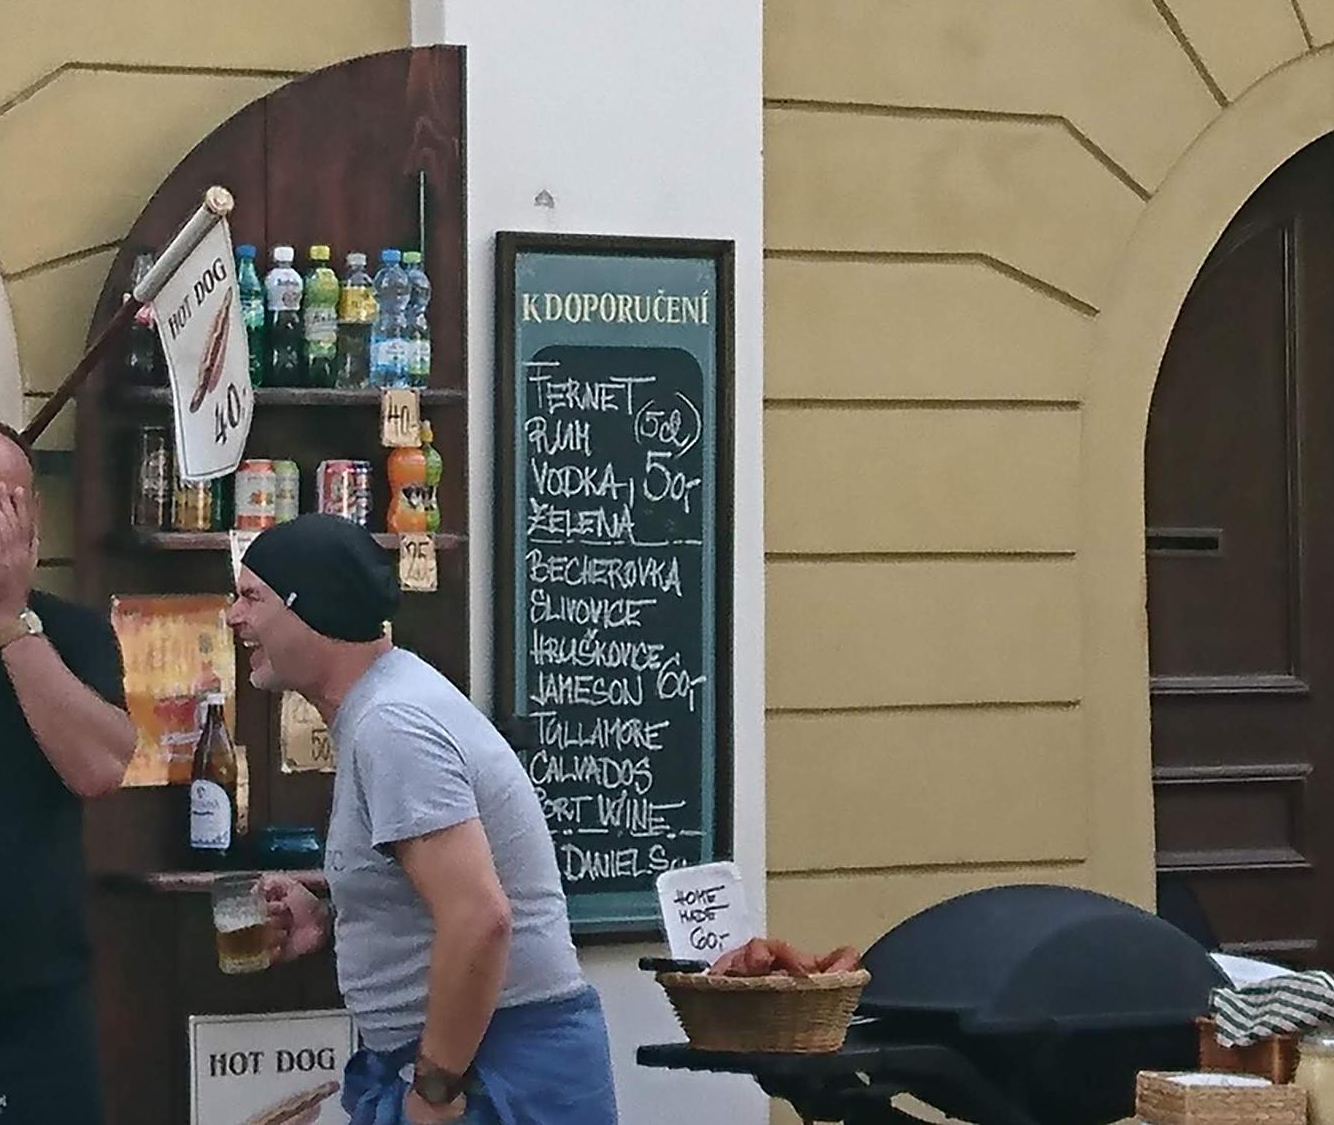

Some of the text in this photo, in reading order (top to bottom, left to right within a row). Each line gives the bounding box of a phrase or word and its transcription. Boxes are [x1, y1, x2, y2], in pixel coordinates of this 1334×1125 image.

[168, 257, 227, 340] HOT DOG
[524, 416, 591, 457] RUM
[530, 458, 627, 500] VODKA
[525, 548, 683, 597] BECHEROVKA
[529, 588, 657, 629] SLIVOVICE
[529, 671, 644, 706] JAMESON
[528, 710, 670, 751] TULLAMORE
[529, 749, 654, 795] CALVADOS
[597, 789, 687, 835] WINE
[209, 1046, 335, 1077] HOT DOG
